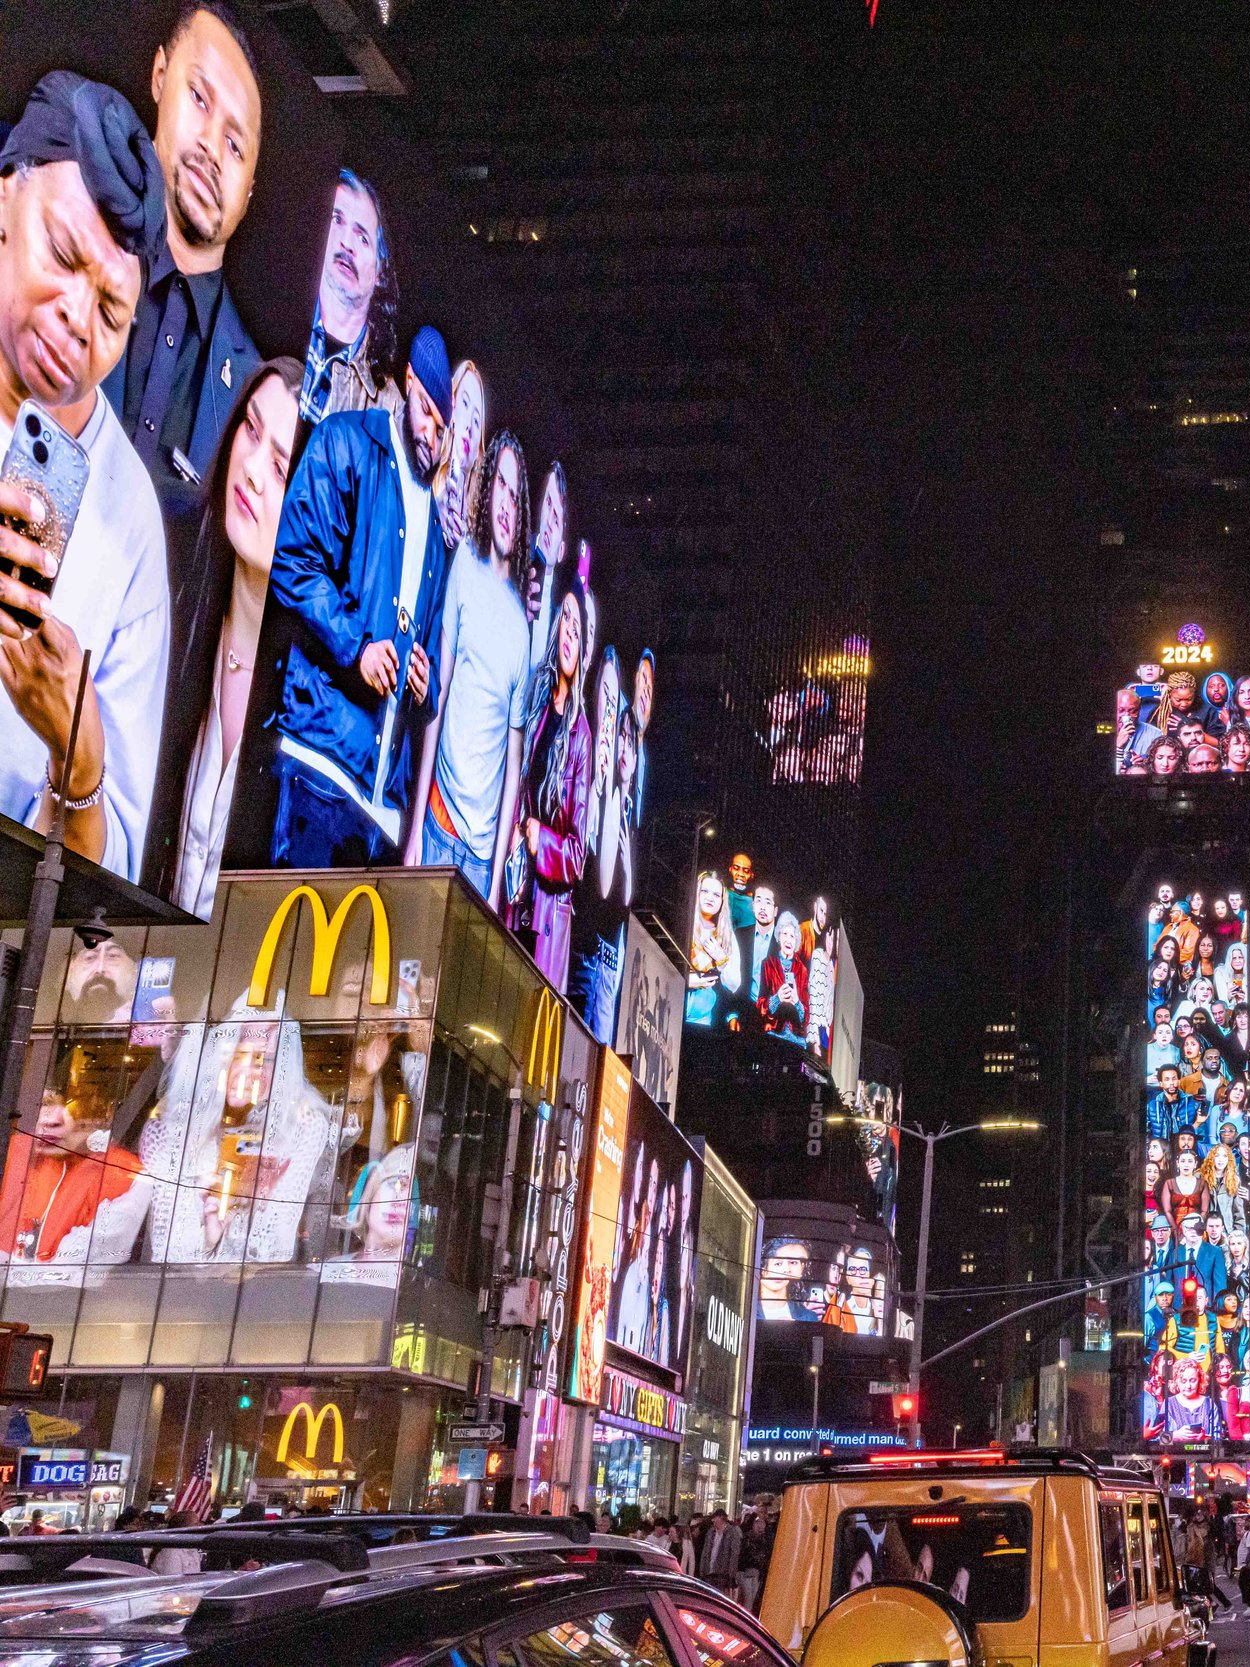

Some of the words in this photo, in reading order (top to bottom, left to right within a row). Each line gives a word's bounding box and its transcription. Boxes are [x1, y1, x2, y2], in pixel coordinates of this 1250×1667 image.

[1162, 646, 1213, 664] 2024
[707, 1294, 724, 1346] OLD
[723, 1306, 745, 1358] NAVY
[637, 1387, 665, 1428] GIFTS
[454, 1429, 470, 1437] ONE
[480, 1428, 497, 1437] WAY
[868, 1436, 894, 1445] man
[763, 1448, 770, 1461] 1
[774, 1450, 791, 1461] on
[32, 1464, 86, 1483] DOG
